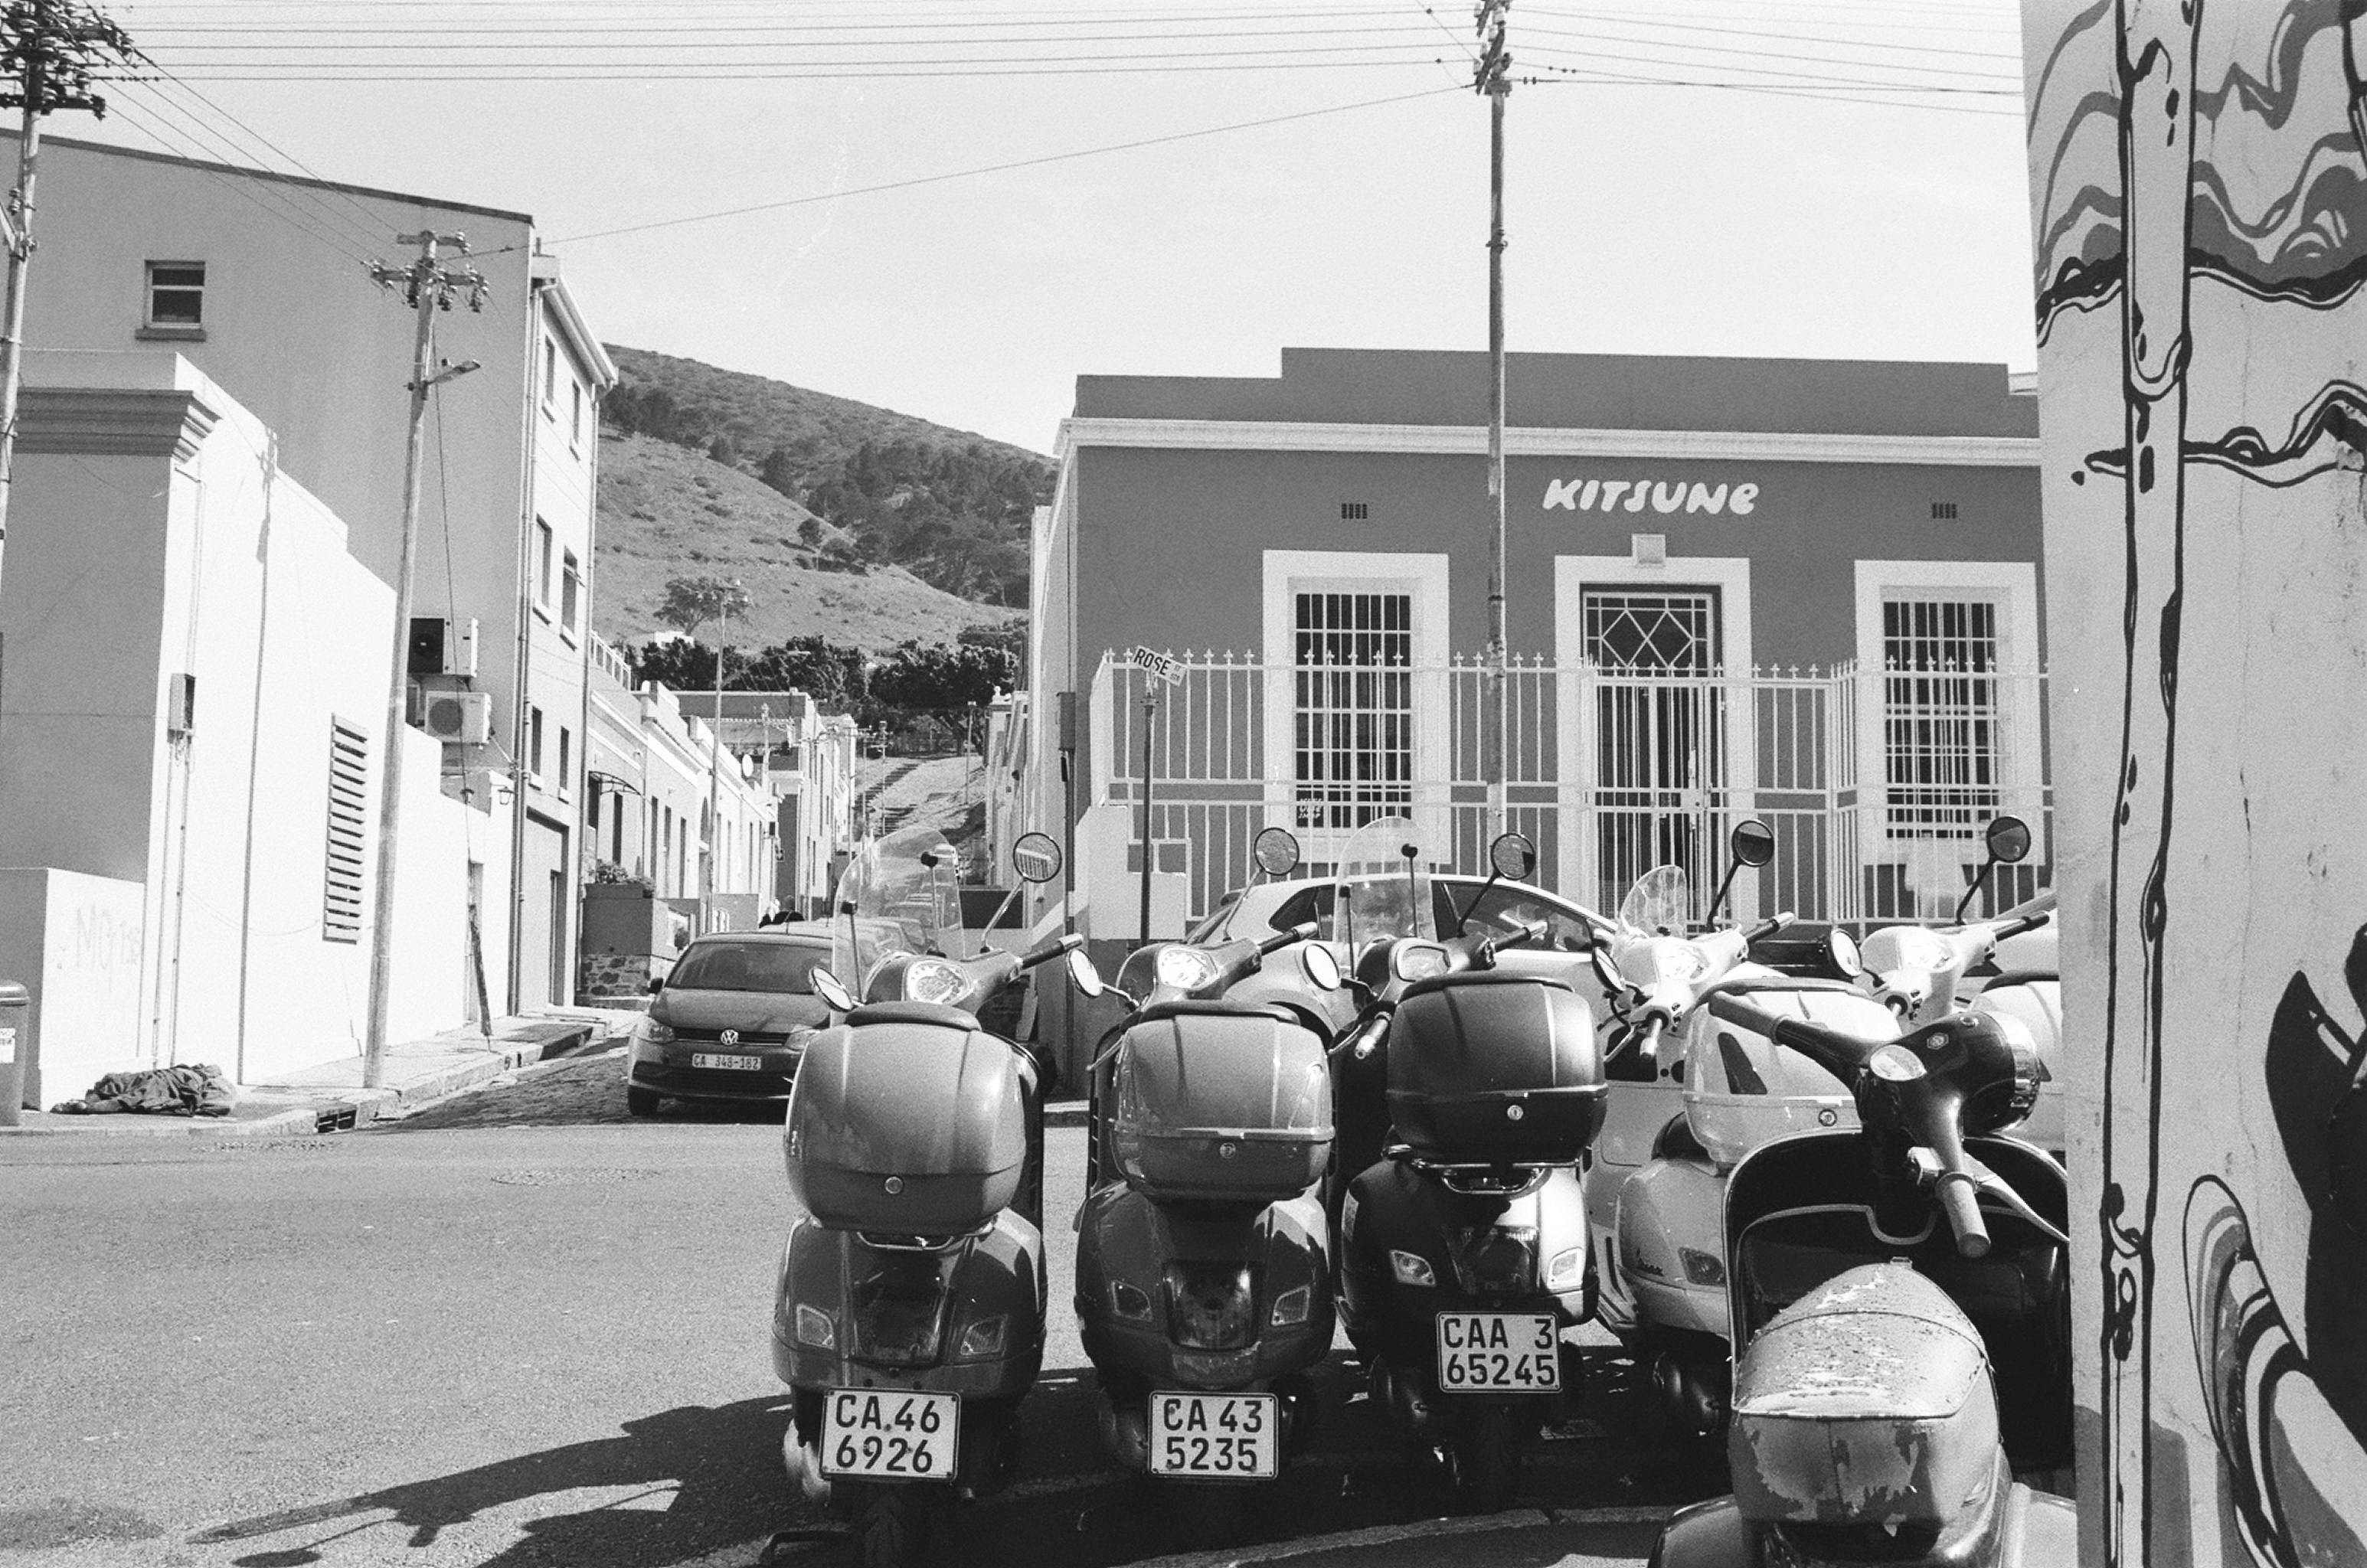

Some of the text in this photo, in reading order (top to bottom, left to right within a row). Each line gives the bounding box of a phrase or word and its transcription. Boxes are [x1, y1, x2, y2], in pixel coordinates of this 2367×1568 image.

[1133, 648, 1171, 675] ROSE
[694, 1054, 706, 1067] CA
[1443, 1318, 1553, 1349] CAA 3
[1447, 1354, 1555, 1386] 65245
[835, 1394, 940, 1433] CA 46
[1163, 1398, 1262, 1433] CA 43
[835, 1434, 933, 1473] 6926
[1166, 1436, 1258, 1472] 5235
